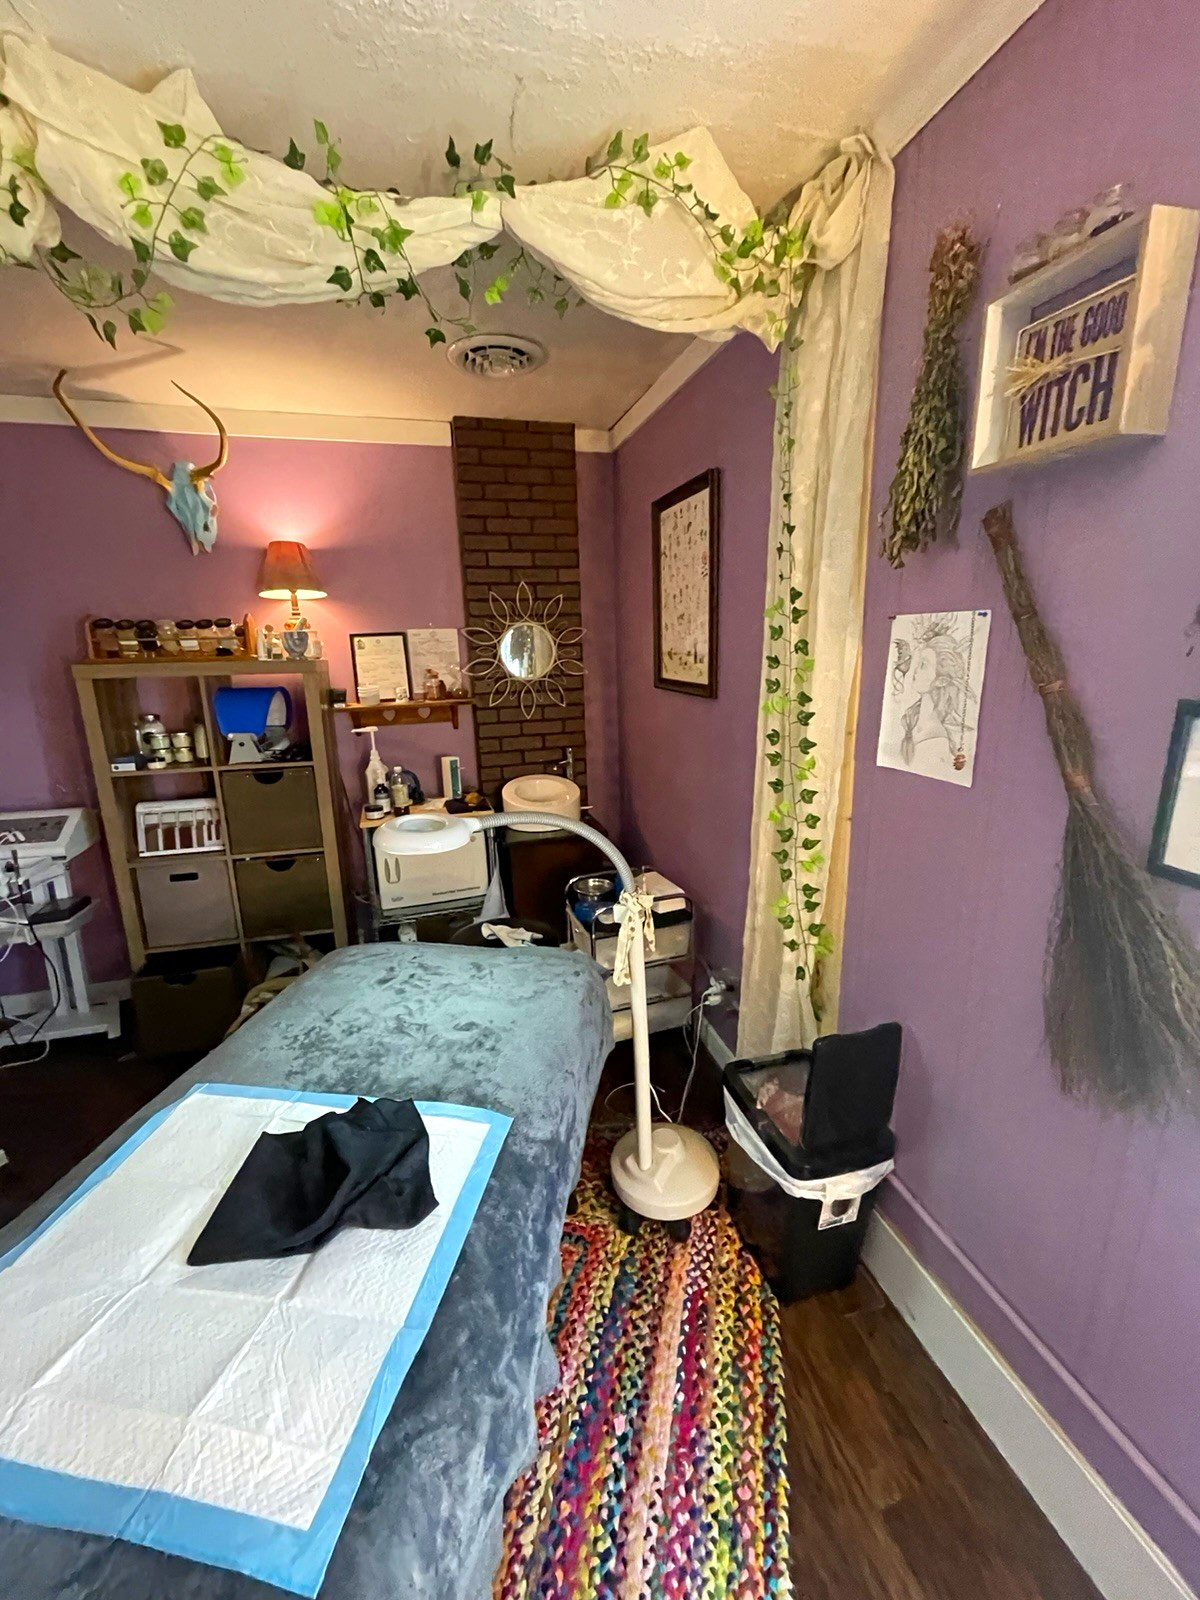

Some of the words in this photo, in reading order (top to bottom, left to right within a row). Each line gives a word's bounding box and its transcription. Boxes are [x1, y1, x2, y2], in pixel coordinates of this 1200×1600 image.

[1050, 312, 1080, 360] THE
[1080, 291, 1130, 348] GOOD
[1018, 351, 1119, 449] WITCH
